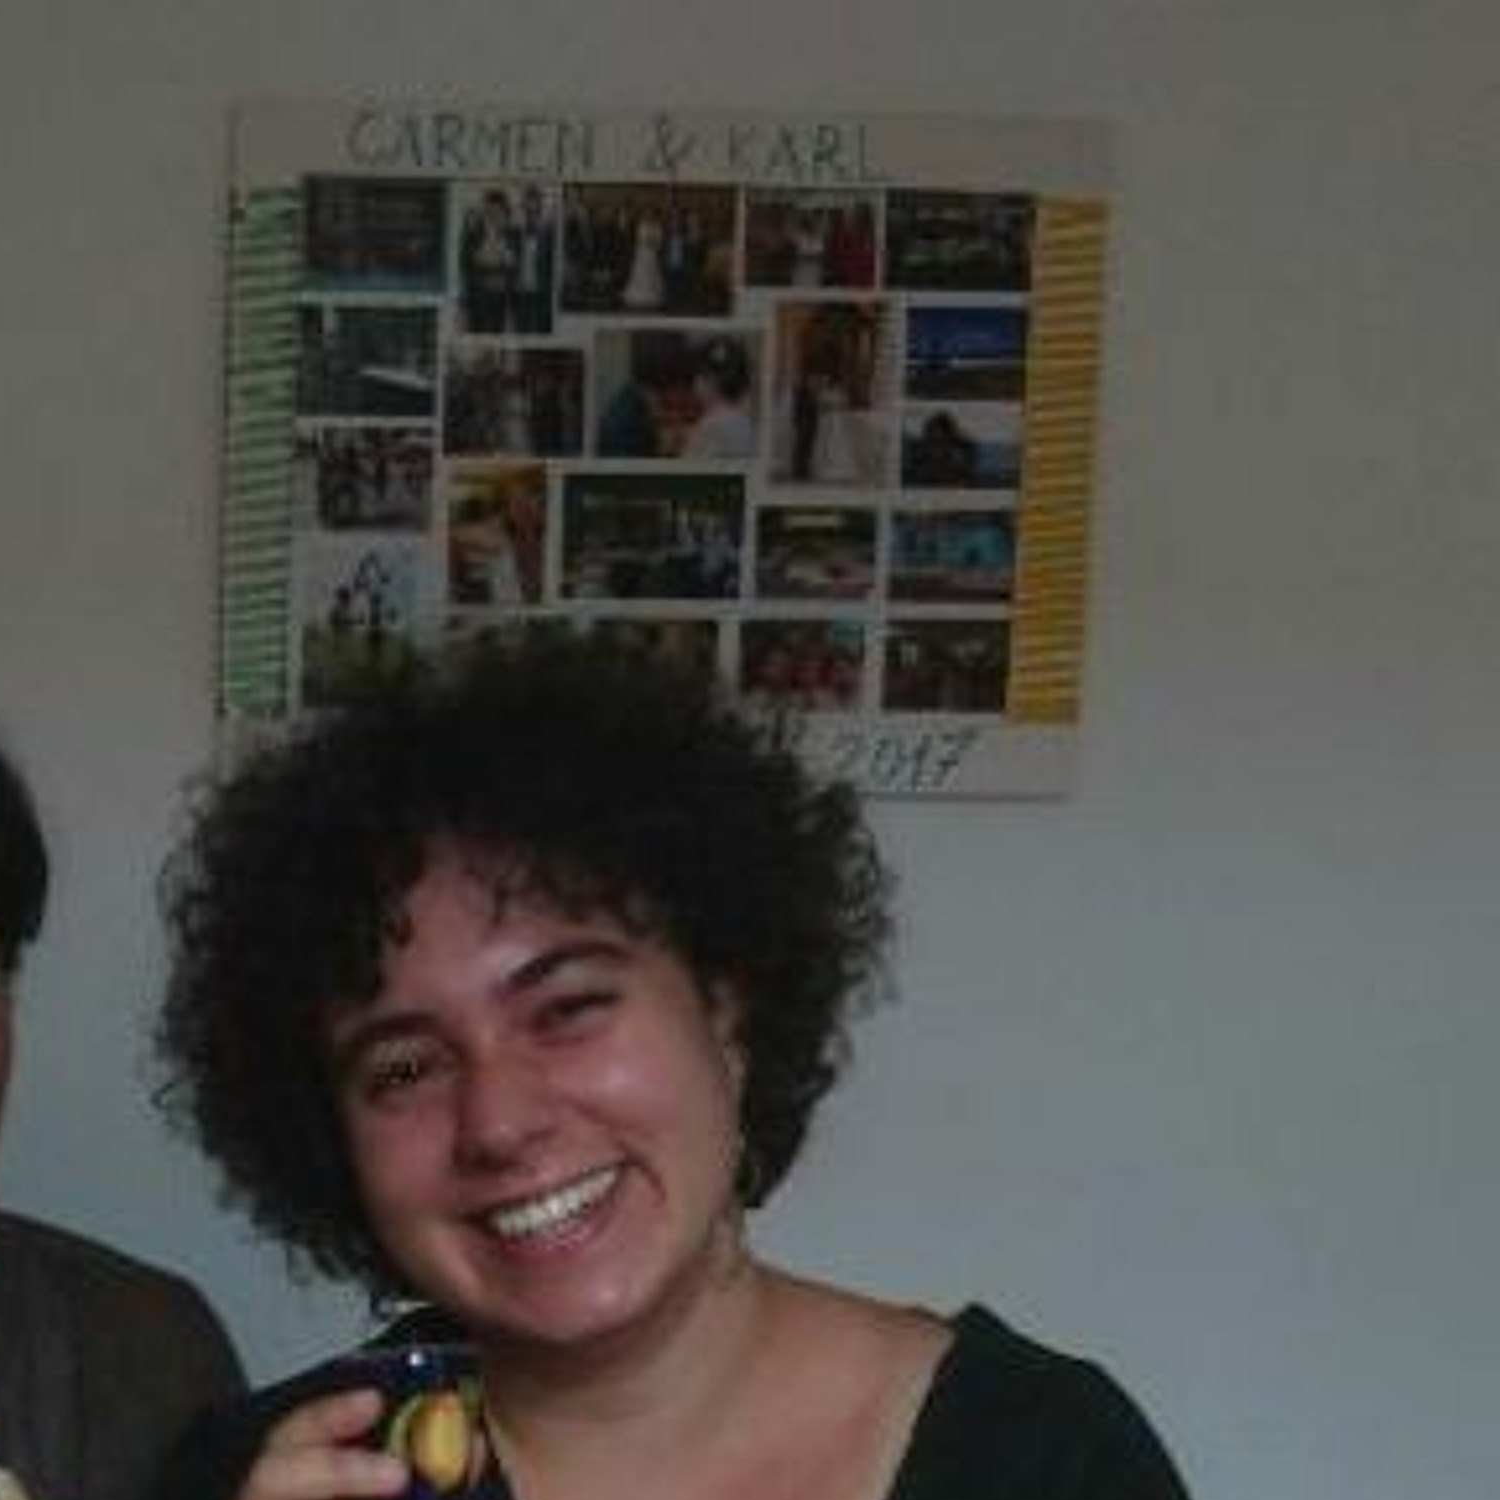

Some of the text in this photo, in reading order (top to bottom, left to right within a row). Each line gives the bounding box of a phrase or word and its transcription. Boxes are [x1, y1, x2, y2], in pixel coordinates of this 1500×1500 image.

[346, 110, 882, 182] CARMEN & KARL
[830, 727, 980, 790] 2017
